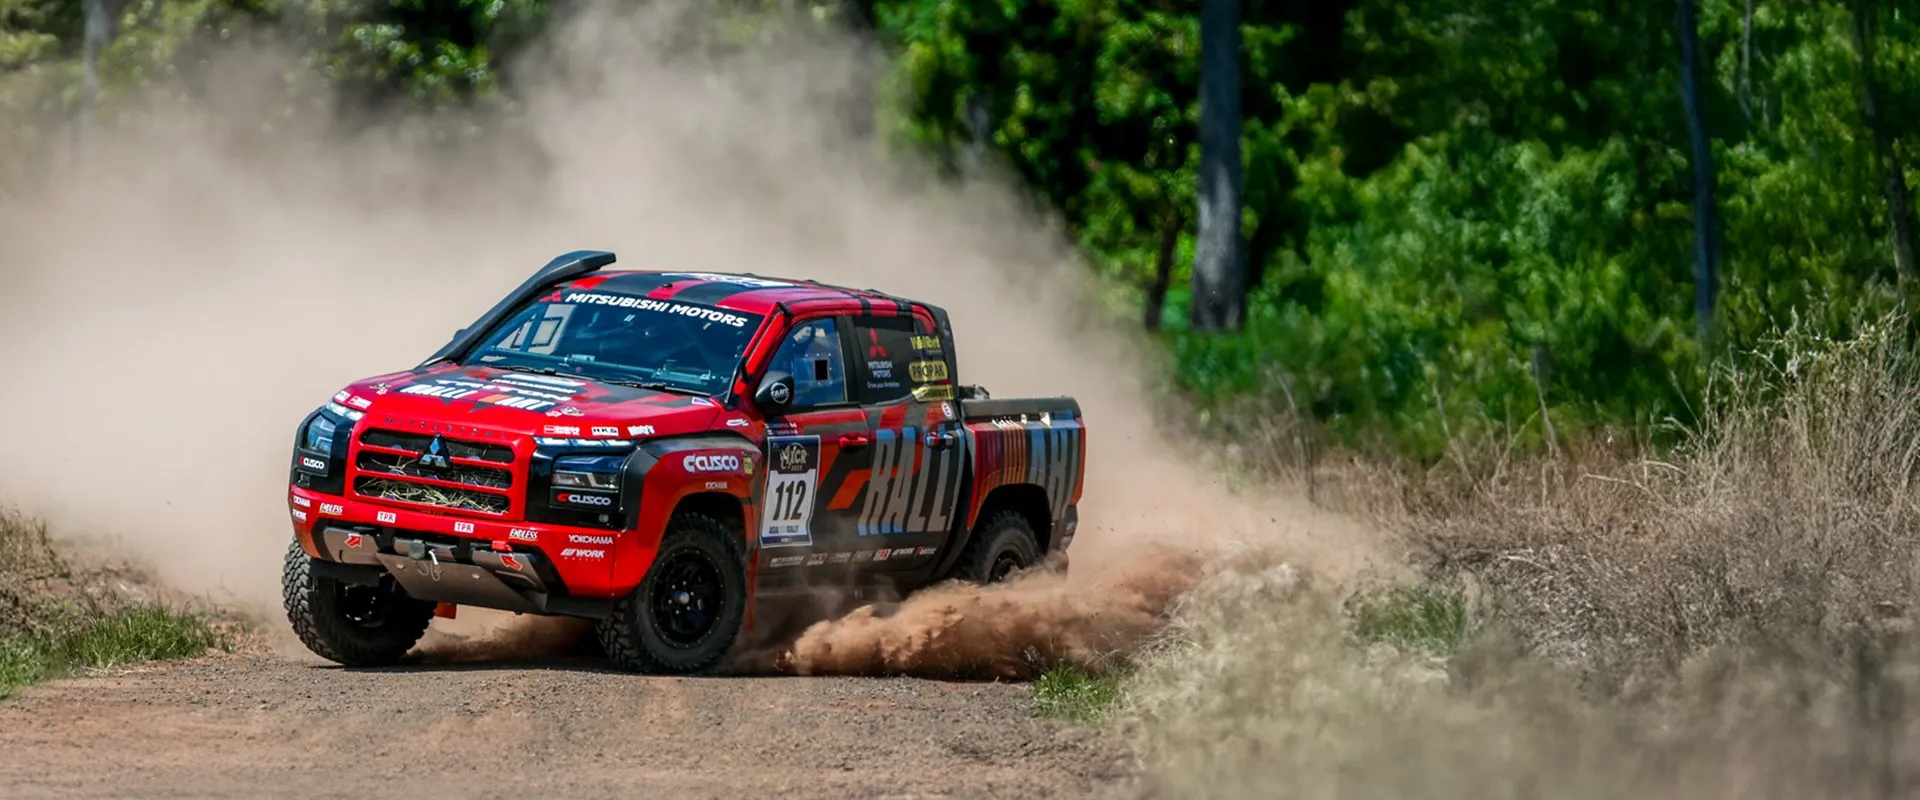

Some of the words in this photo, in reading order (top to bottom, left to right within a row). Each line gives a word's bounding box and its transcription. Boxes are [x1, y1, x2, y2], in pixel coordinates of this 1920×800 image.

[565, 292, 669, 313] MITSUBISHI
[671, 304, 748, 328] MOTORS
[592, 426, 619, 435] HKS
[303, 457, 325, 470] CUSCO
[695, 454, 740, 472] CUSCO
[568, 494, 612, 506] CUSCO
[772, 480, 807, 521] 112
[319, 502, 344, 514] ENDLESS
[379, 512, 394, 522] TPR
[456, 523, 473, 532] TPR
[509, 529, 539, 540] ENDLESS
[568, 534, 614, 545] YOKOHAMA
[576, 549, 606, 559] WORK
